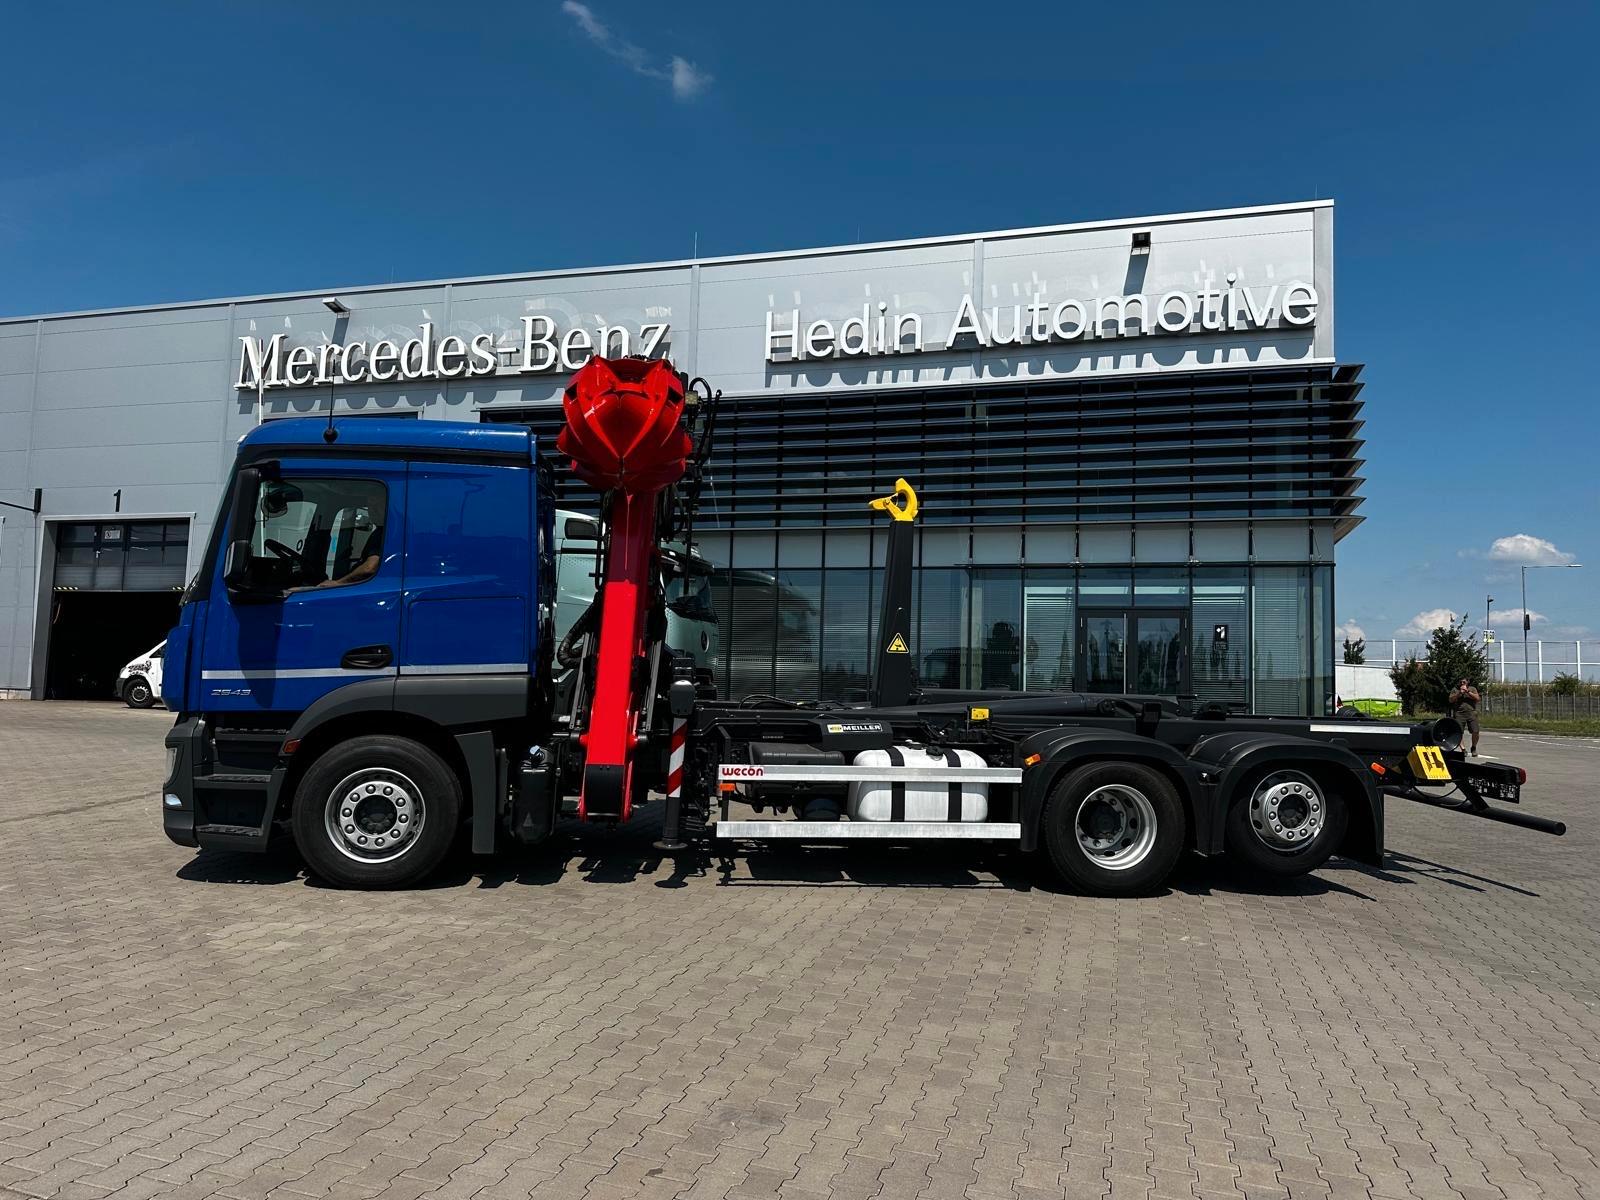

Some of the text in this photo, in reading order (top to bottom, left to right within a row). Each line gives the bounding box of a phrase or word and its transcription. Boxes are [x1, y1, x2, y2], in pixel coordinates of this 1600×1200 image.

[765, 272, 1319, 360] Hedin Automotive
[233, 315, 671, 391] Mercedes-Benz
[113, 488, 122, 513] 1
[721, 767, 764, 776] wecon
